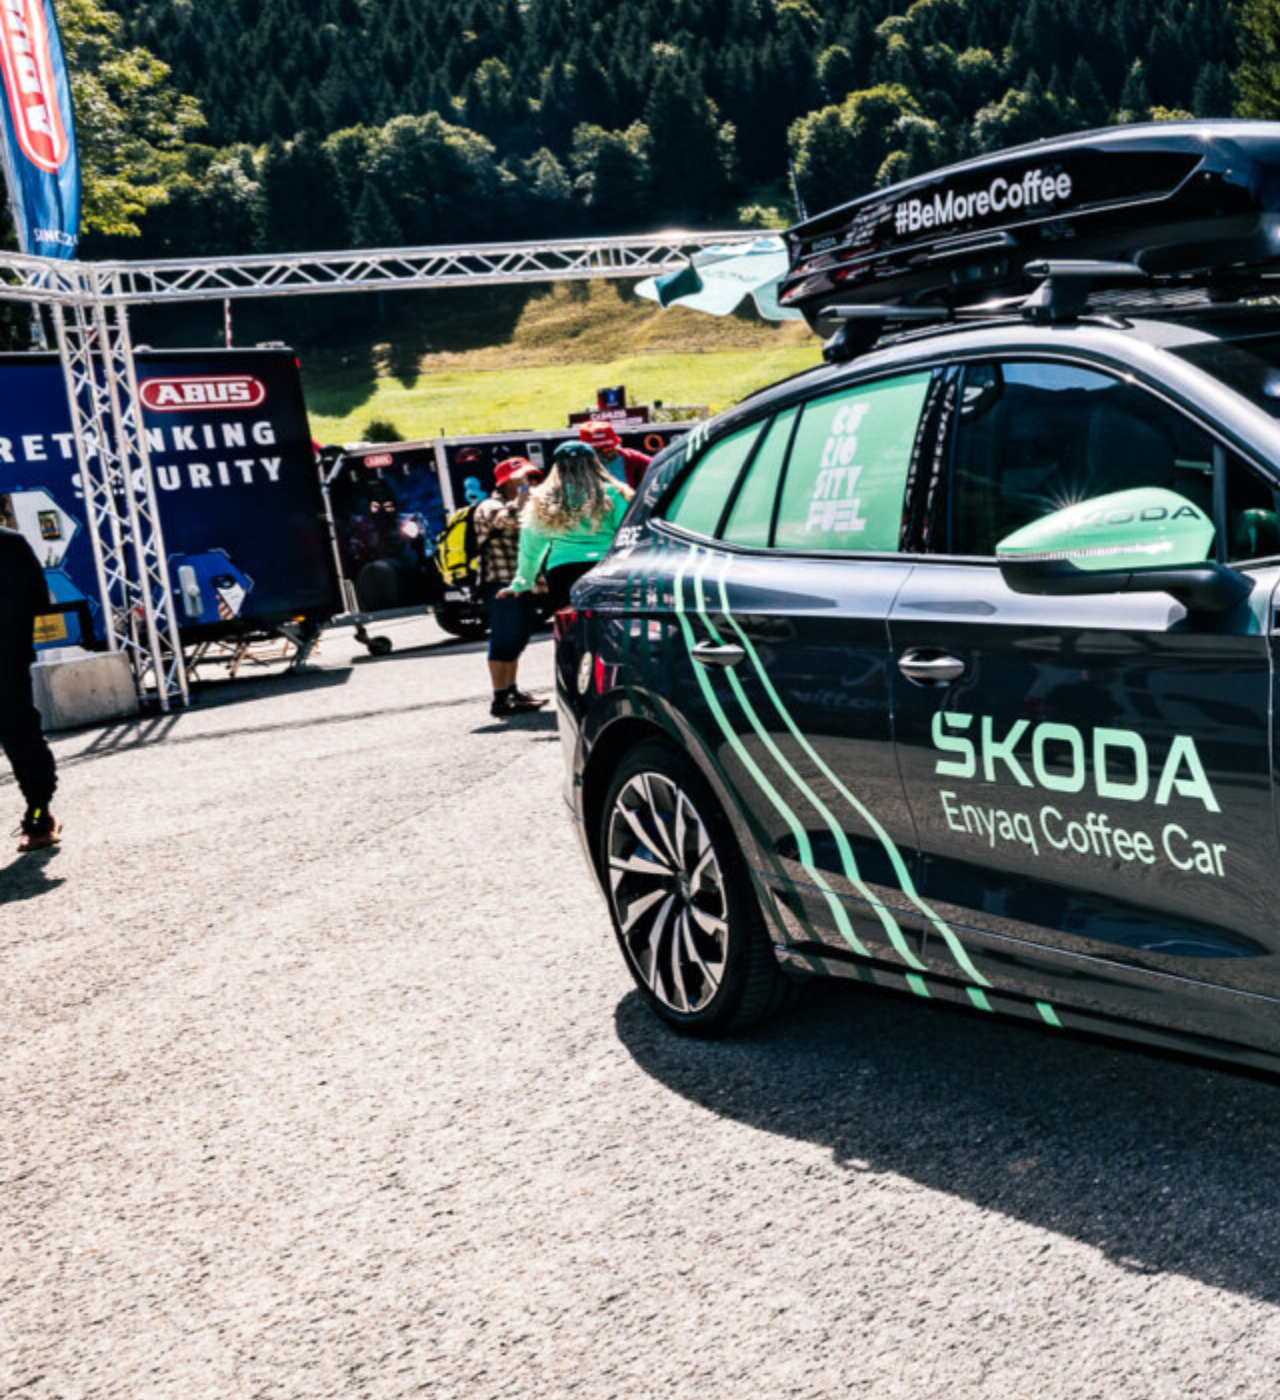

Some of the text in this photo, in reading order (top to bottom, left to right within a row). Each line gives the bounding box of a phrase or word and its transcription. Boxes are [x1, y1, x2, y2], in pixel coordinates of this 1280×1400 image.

[895, 169, 1072, 234] #BeMoreCoffee
[156, 381, 251, 405] ABUS
[939, 790, 1228, 877] Enyaq Coffee Car
